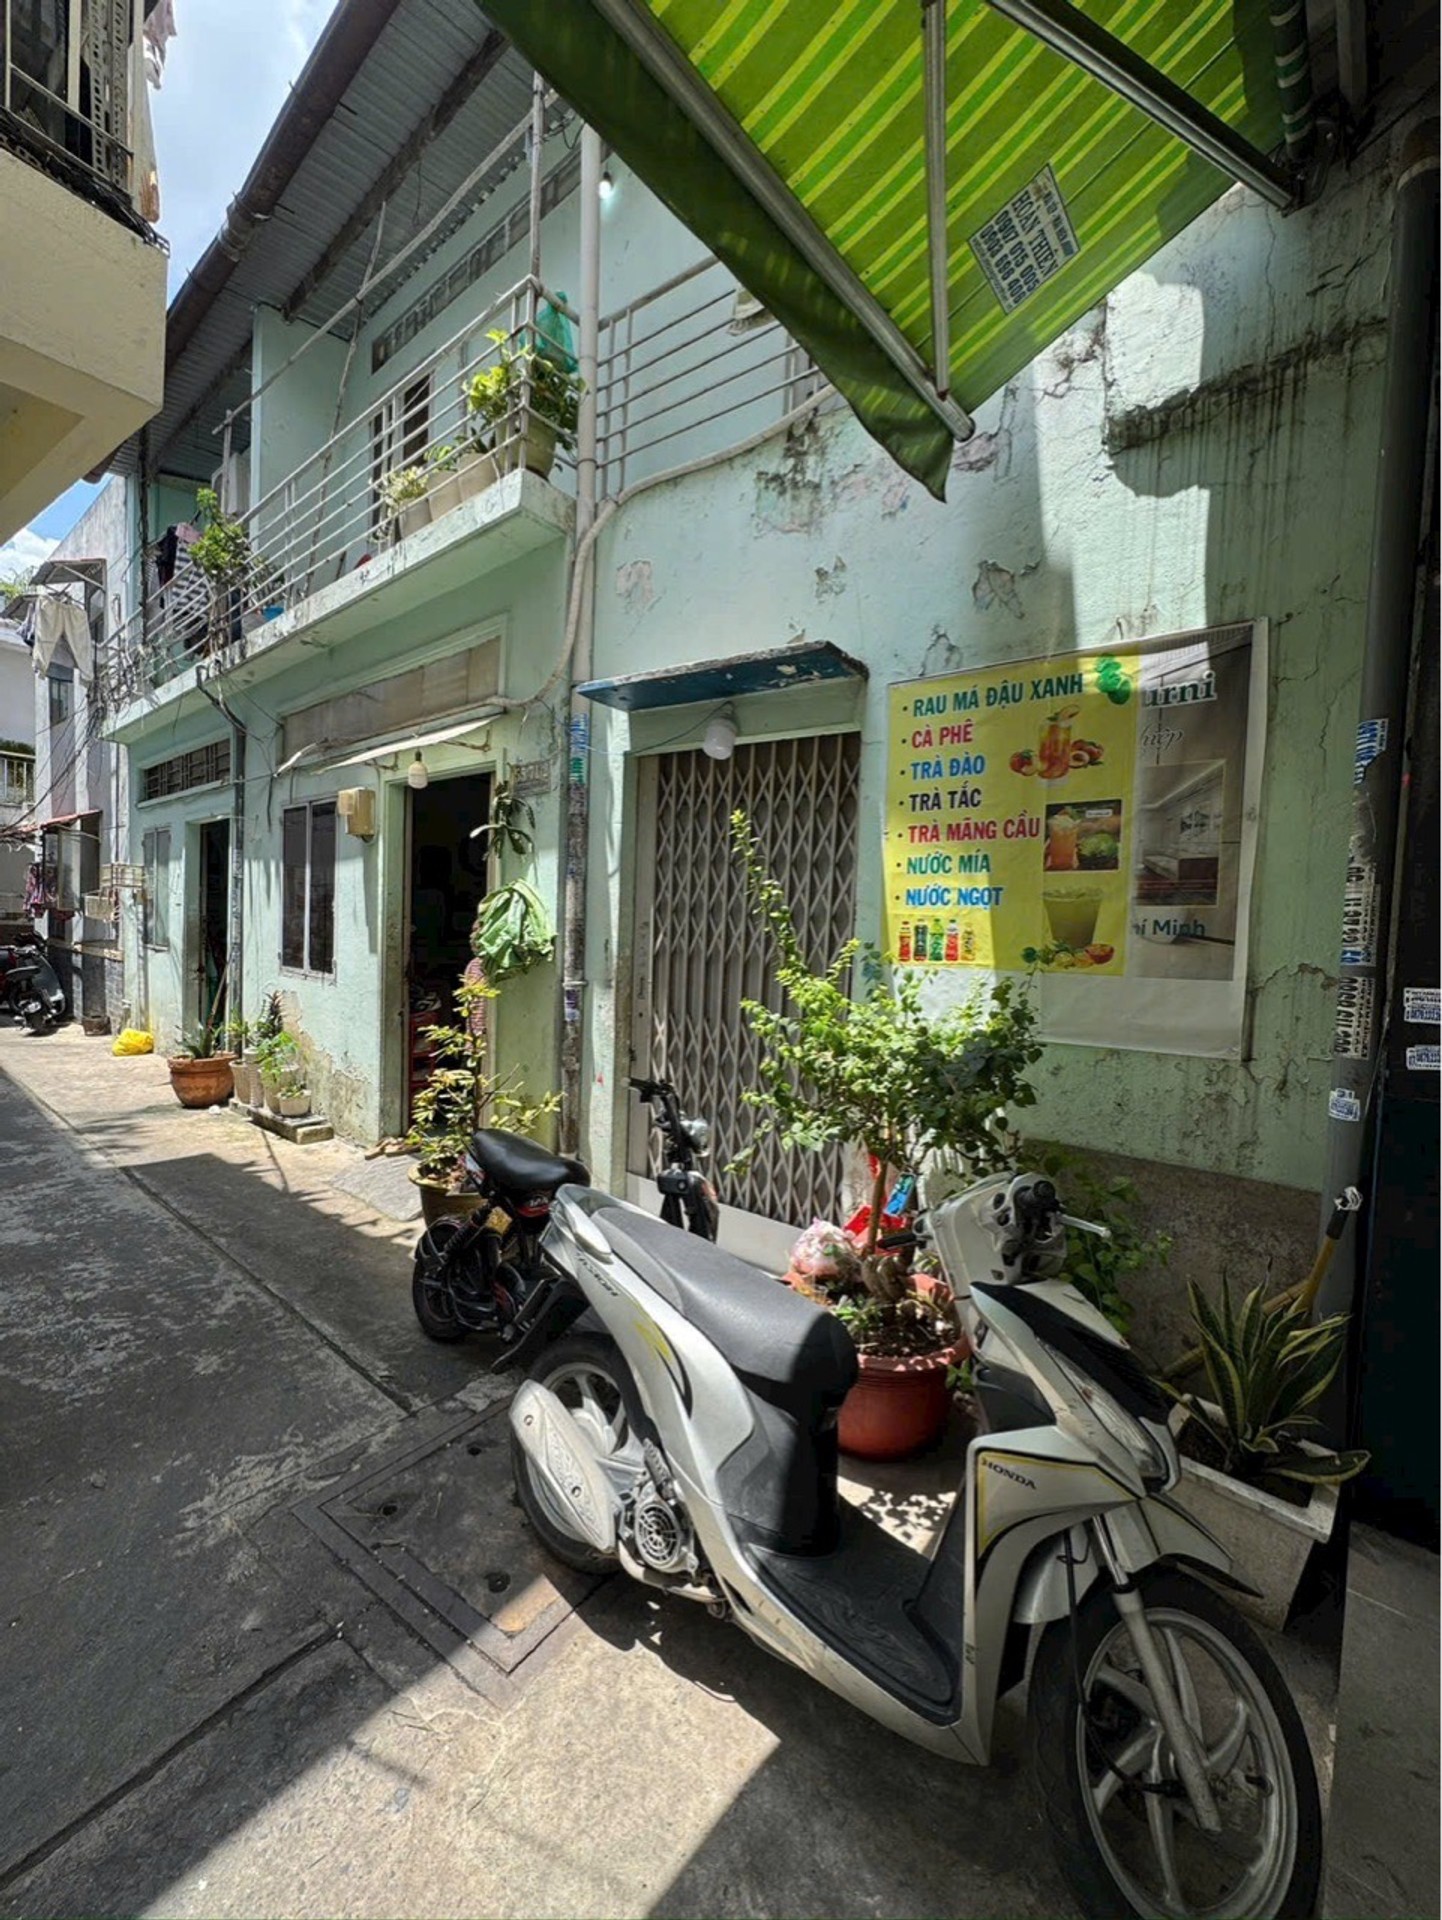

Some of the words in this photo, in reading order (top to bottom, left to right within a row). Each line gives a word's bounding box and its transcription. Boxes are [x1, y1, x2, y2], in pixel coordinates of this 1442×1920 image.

[913, 694, 947, 717] RAU
[952, 684, 979, 711] MÁ
[985, 679, 1023, 709] ĐẬU
[1029, 673, 1083, 700] XANH
[911, 724, 933, 748] CÀ
[939, 718, 974, 746] PHÊ
[910, 754, 943, 780] TRÀ
[949, 751, 985, 777] ĐÀO
[908, 786, 942, 812] TRÀ
[947, 780, 982, 809] TẮC
[907, 819, 940, 843] TRÀ
[1003, 809, 1040, 838] CẦU
[906, 850, 953, 874] NƯỚC
[958, 848, 991, 873] MÍA
[905, 883, 951, 906] NƯỚC
[957, 886, 1004, 910] NGỌT
[1152, 918, 1206, 937] Minh
[981, 1457, 1037, 1490] HONDA
